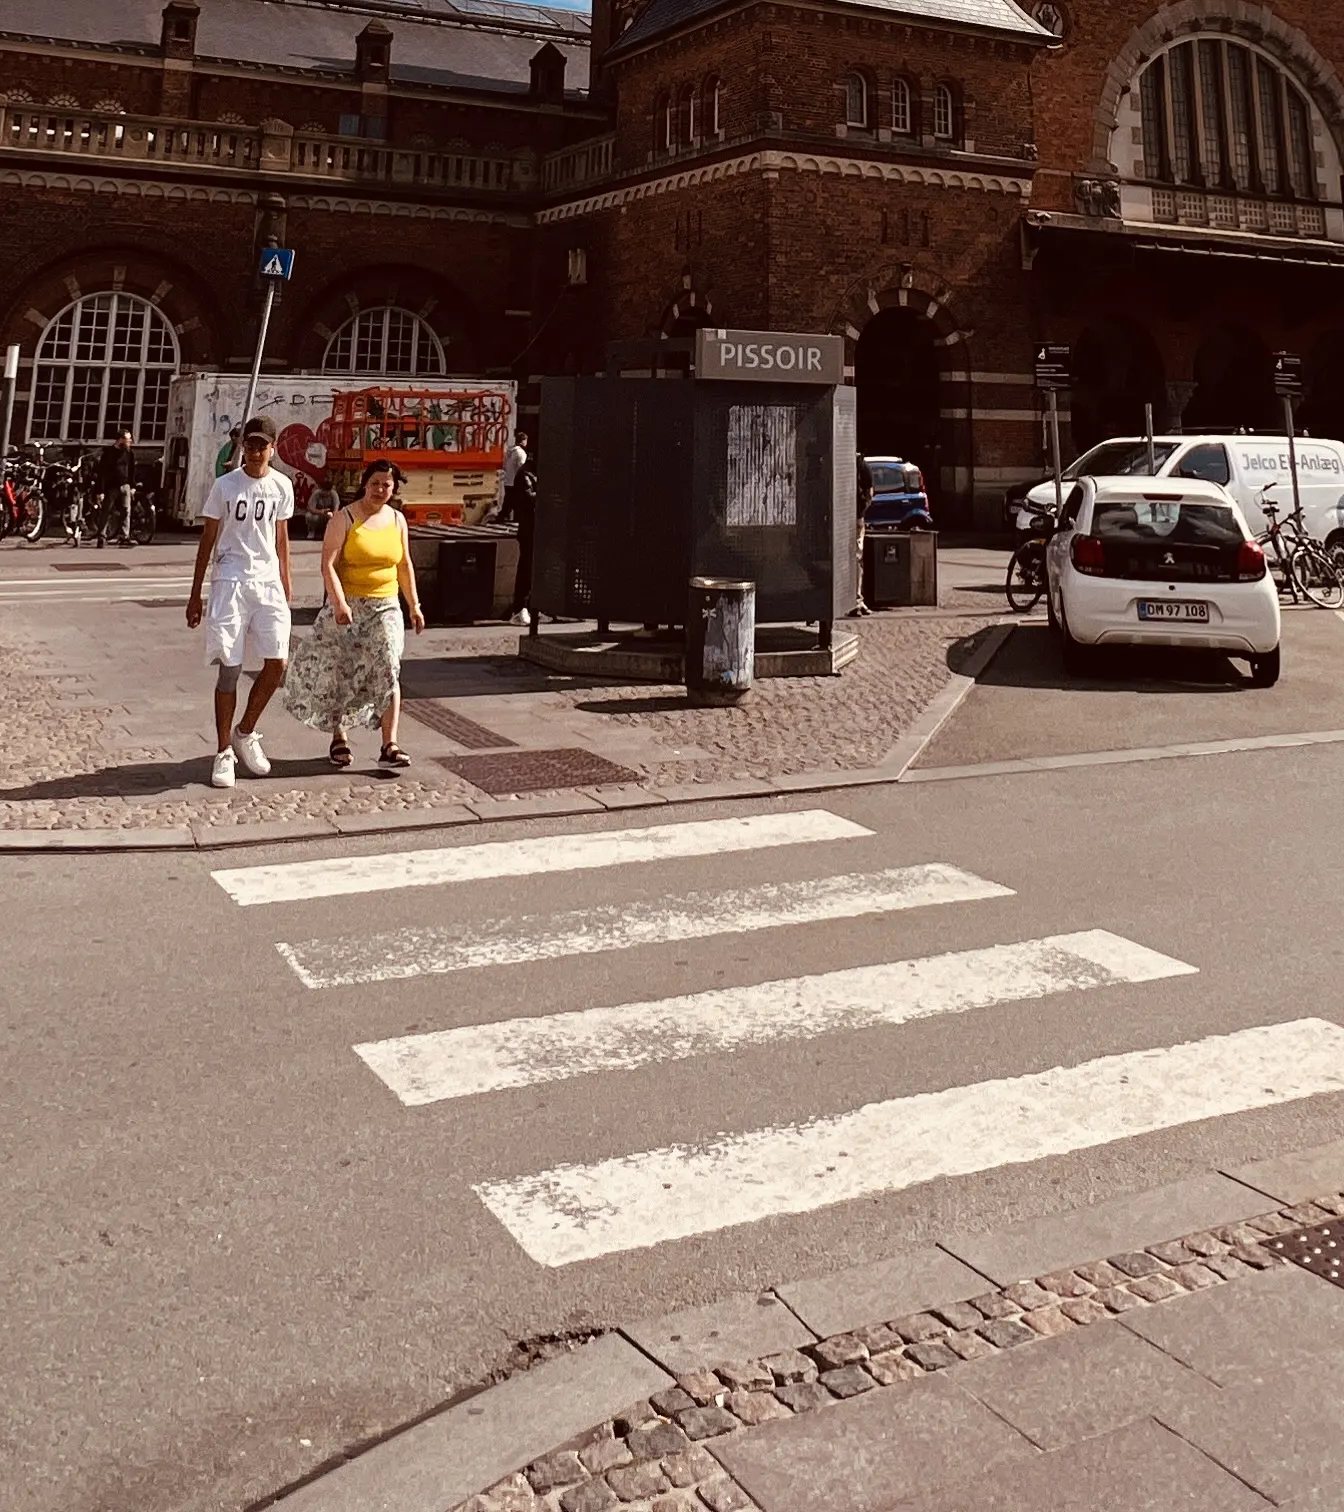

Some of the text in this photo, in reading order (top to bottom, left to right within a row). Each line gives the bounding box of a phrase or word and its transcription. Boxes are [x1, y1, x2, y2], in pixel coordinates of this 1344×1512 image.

[720, 343, 823, 371] PISSOIR
[1242, 454, 1339, 474] Jelco E-Anlæg
[1166, 605, 1180, 616] 97
[1185, 605, 1206, 617] 108
